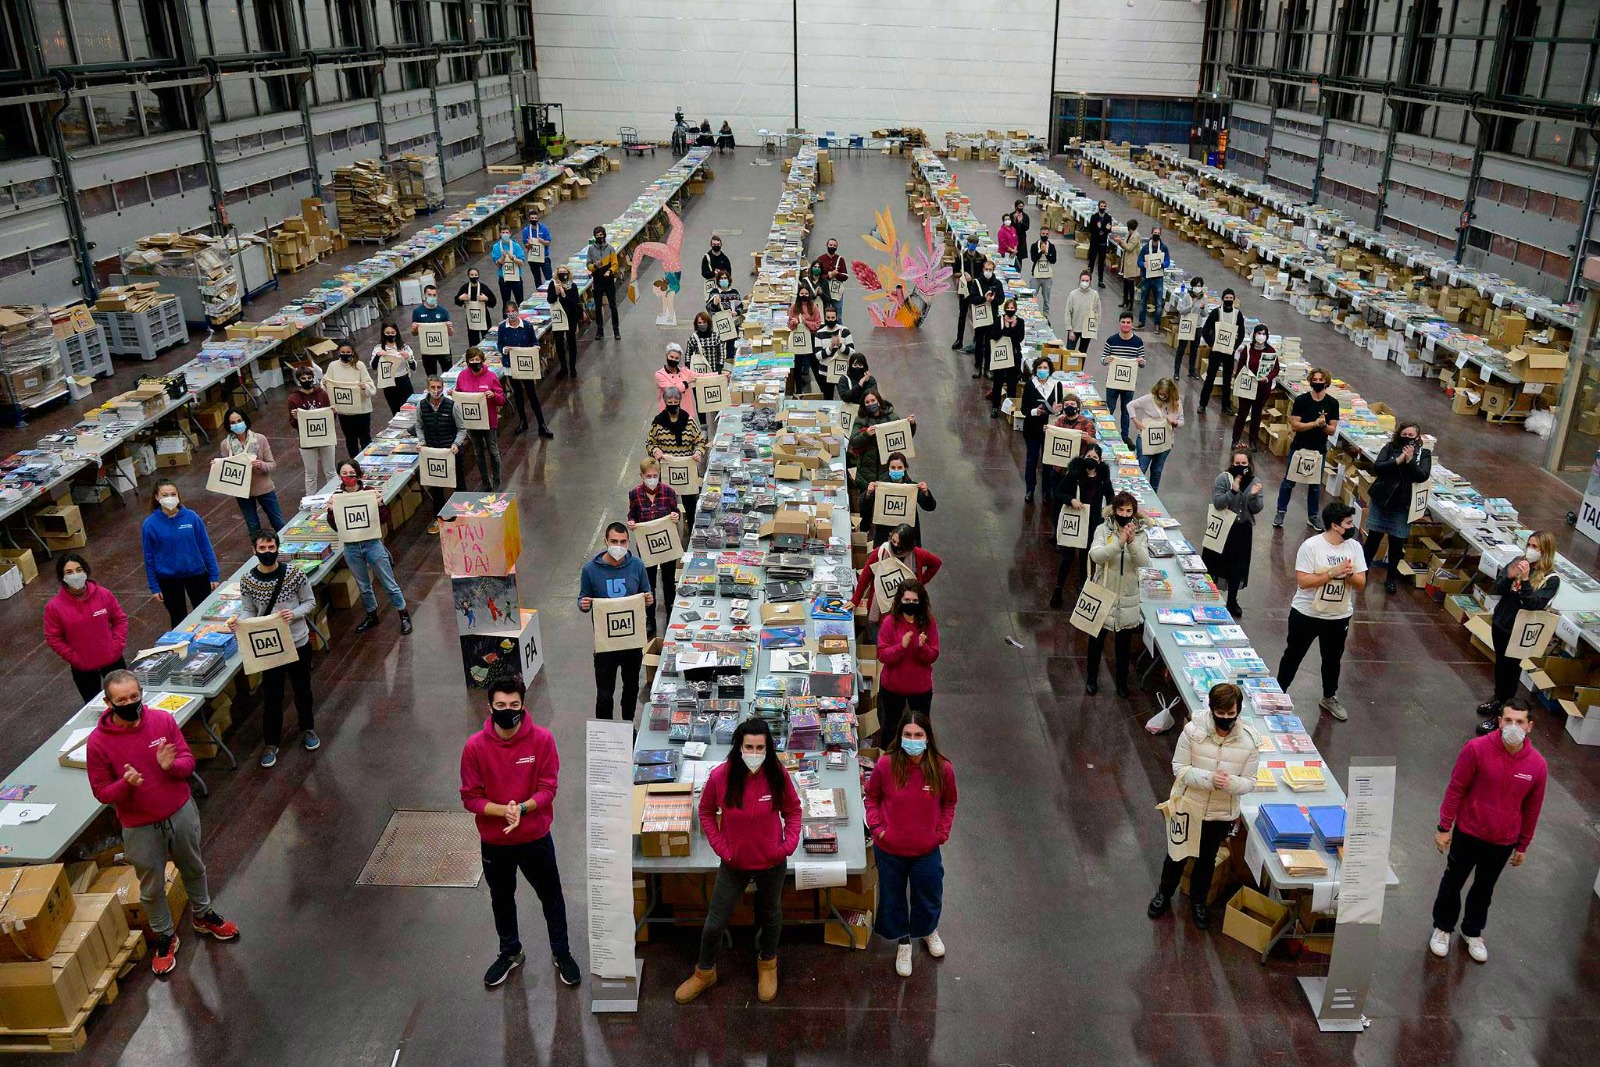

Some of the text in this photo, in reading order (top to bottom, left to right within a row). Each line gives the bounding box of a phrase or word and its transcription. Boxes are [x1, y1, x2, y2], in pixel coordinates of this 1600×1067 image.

[1218, 334, 1228, 342] DA!
[1116, 369, 1128, 377] DA!
[336, 391, 350, 400] DA!
[707, 390, 719, 398] DA!
[465, 408, 478, 416] DA!
[310, 423, 324, 432] DA!
[888, 436, 902, 446] DA!
[1150, 432, 1162, 440] DA!
[1054, 442, 1068, 452] DA!
[430, 463, 444, 472] DA!
[224, 467, 242, 479] DA!
[672, 472, 686, 480] DA!
[888, 500, 903, 510] DA!
[348, 512, 366, 523] DA!
[1063, 520, 1076, 530] DA!
[1208, 522, 1218, 532] A!
[455, 522, 485, 541] TAU
[651, 536, 667, 548] DA!
[461, 542, 482, 554] PA
[464, 554, 490, 573] DA!
[1326, 584, 1342, 595] DA!
[1078, 598, 1095, 614] DA!
[612, 618, 630, 630] DA!
[255, 637, 278, 650] DA!
[524, 636, 538, 669] PA
